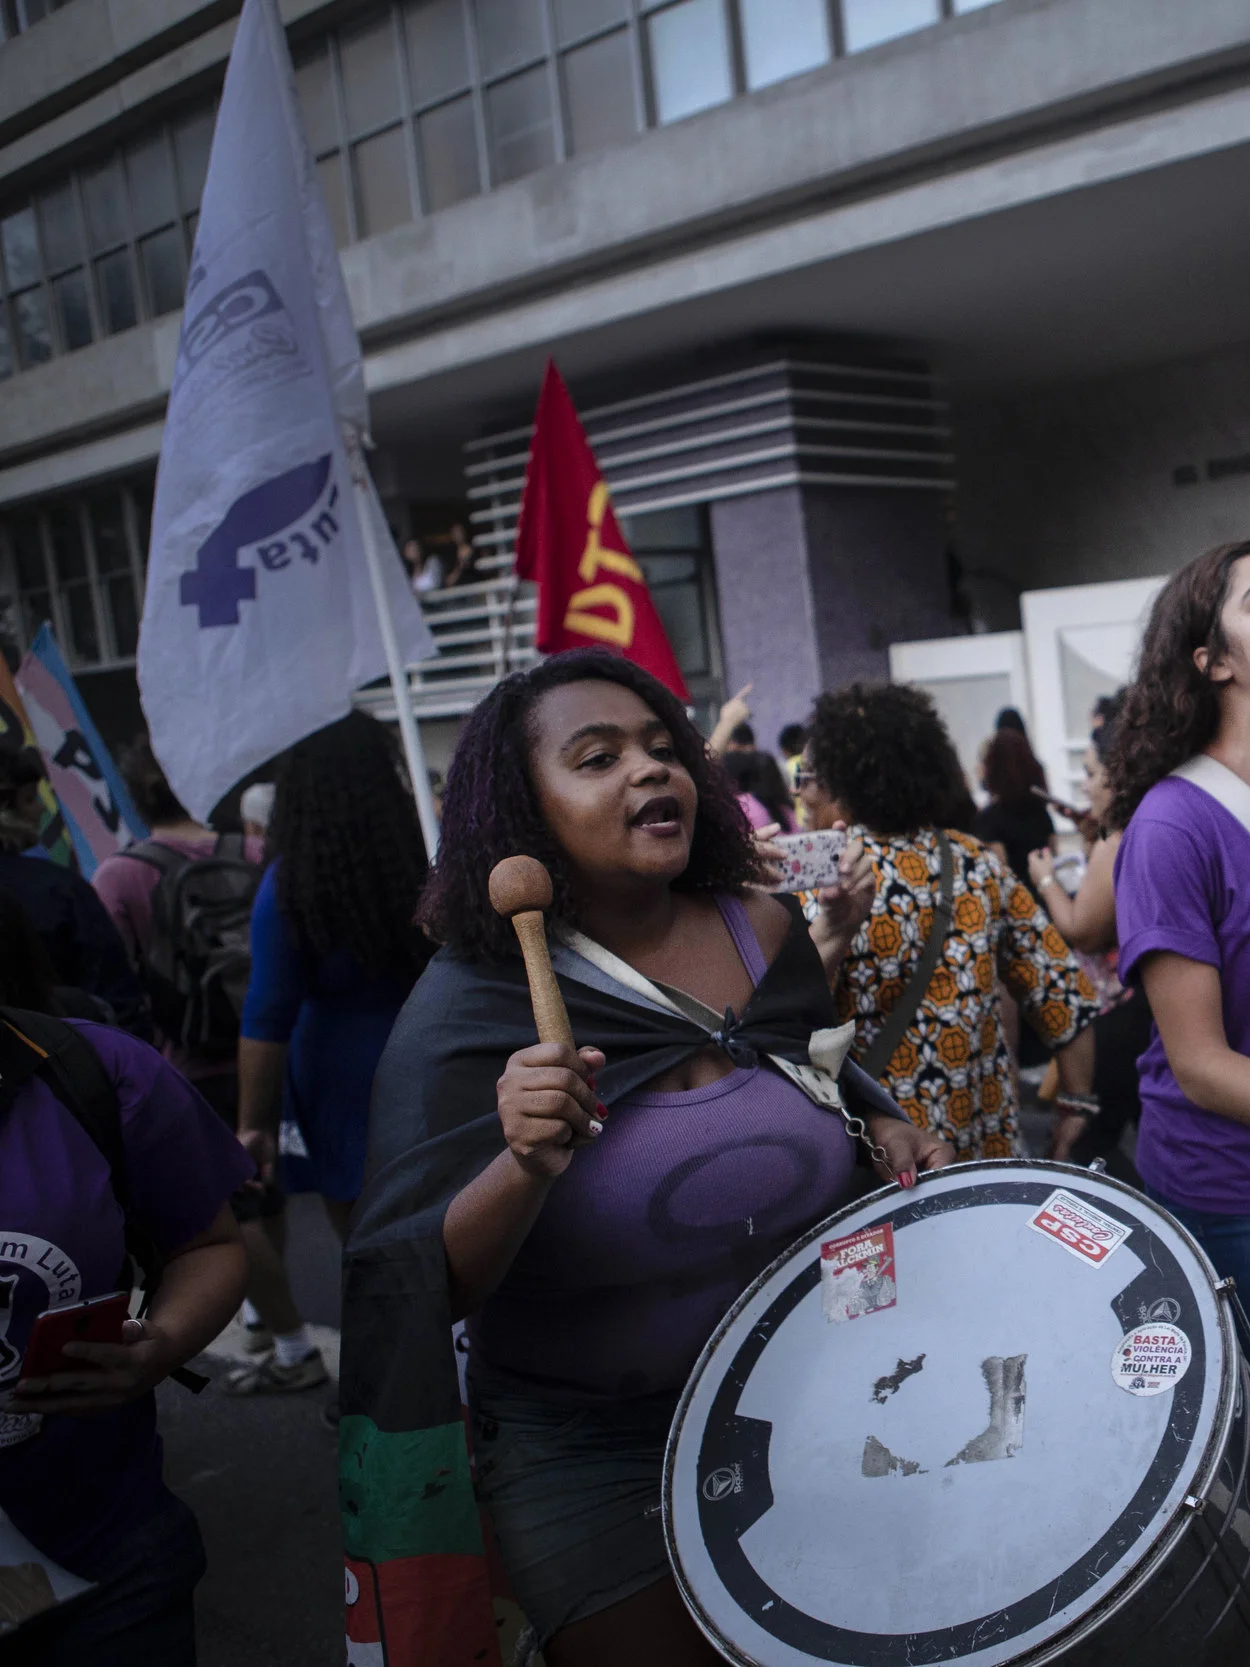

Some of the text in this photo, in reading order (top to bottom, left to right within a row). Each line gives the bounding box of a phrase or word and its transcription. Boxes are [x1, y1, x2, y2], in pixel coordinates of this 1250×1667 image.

[1053, 1204, 1114, 1241] Conlutas
[1040, 1218, 1102, 1256] CSP
[835, 1243, 885, 1269] LCKMIN
[840, 1239, 873, 1259] FORA
[0, 1241, 79, 1301] m Luta
[1133, 1335, 1176, 1345] BASTA
[1133, 1345, 1184, 1354] VIOLÊNCIA
[1120, 1363, 1178, 1375] MULHER
[1133, 1355, 1172, 1364] CONTRA
[1174, 1356, 1182, 1364] A
